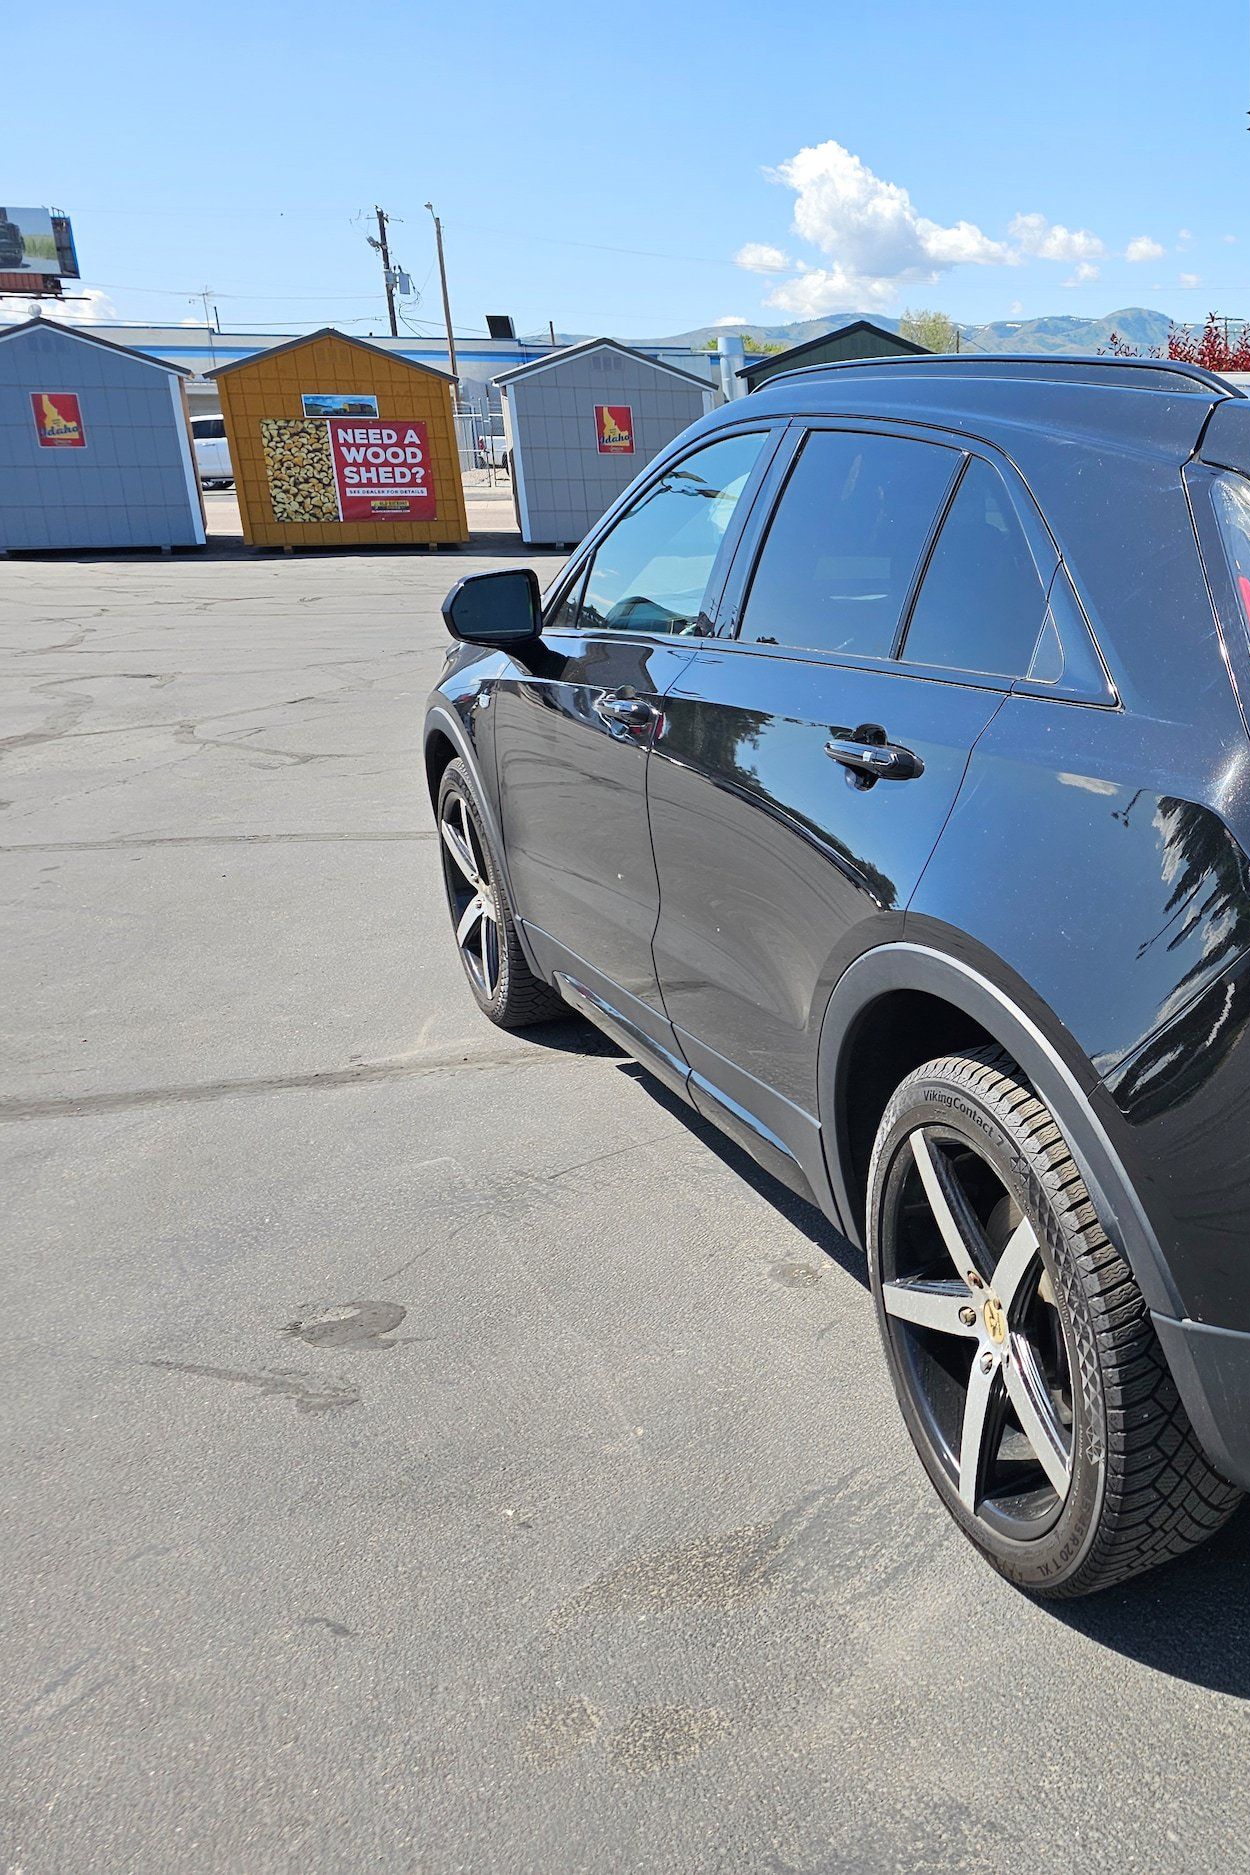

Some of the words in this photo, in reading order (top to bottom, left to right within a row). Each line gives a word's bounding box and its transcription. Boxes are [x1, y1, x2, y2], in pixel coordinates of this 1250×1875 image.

[337, 428, 398, 444] NEED
[403, 429, 421, 444] A
[601, 433, 630, 444] Idaho
[340, 446, 423, 464] WOOD
[343, 466, 425, 484] SHED?
[923, 1090, 994, 1138] VikingContact
[994, 1135, 1005, 1148] 7
